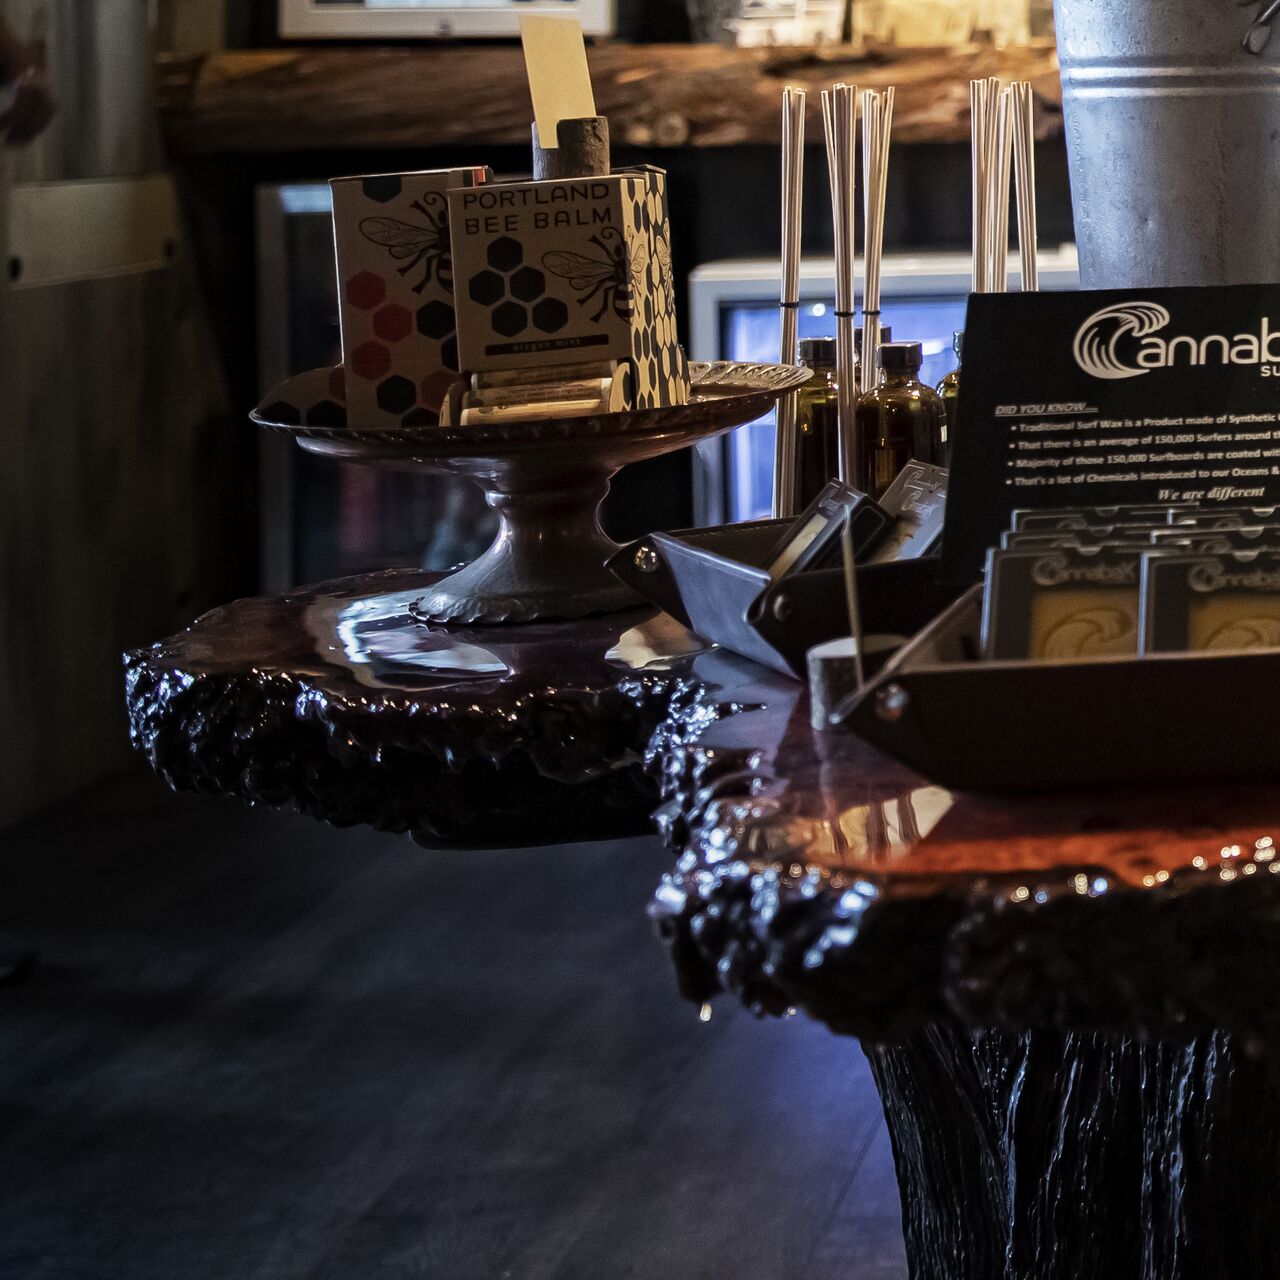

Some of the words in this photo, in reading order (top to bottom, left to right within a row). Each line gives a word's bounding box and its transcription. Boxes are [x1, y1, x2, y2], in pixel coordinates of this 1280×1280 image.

[463, 183, 610, 210] PORTLAND
[465, 214, 519, 235] BEE
[534, 207, 611, 229] BALM
[995, 405, 1017, 416] DID
[1020, 404, 1044, 415] YOU
[1019, 422, 1075, 432] Traditional
[1077, 420, 1098, 430] Surf
[1100, 420, 1122, 428] Wax
[1125, 419, 1133, 427] is
[1144, 417, 1183, 426] Product
[1186, 416, 1214, 425] made
[1216, 415, 1228, 424] of
[1229, 413, 1276, 425] Synthetic
[1018, 441, 1041, 449] That
[1043, 440, 1070, 449] there
[1073, 439, 1082, 448] is
[1083, 439, 1097, 447] an
[1099, 438, 1139, 448] average
[1141, 436, 1153, 445] of
[1155, 434, 1195, 445] 150,000
[1197, 433, 1233, 442] Surfers
[1235, 431, 1271, 441] around
[1015, 459, 1061, 469] Majority
[1062, 457, 1074, 466] of
[1075, 456, 1104, 465] those
[1107, 454, 1147, 464] 150,000
[1149, 451, 1204, 463] Surfboards
[1207, 451, 1224, 460] are
[1226, 449, 1261, 460] coated
[1057, 475, 1072, 484] lot
[1073, 474, 1085, 483] of
[1086, 472, 1139, 482] Chemicals
[1140, 470, 1196, 481] introduced
[1199, 469, 1210, 478] to
[1212, 469, 1230, 478] our
[1232, 467, 1270, 477] Oceans
[1158, 489, 1179, 500] We
[1207, 486, 1266, 501] different
